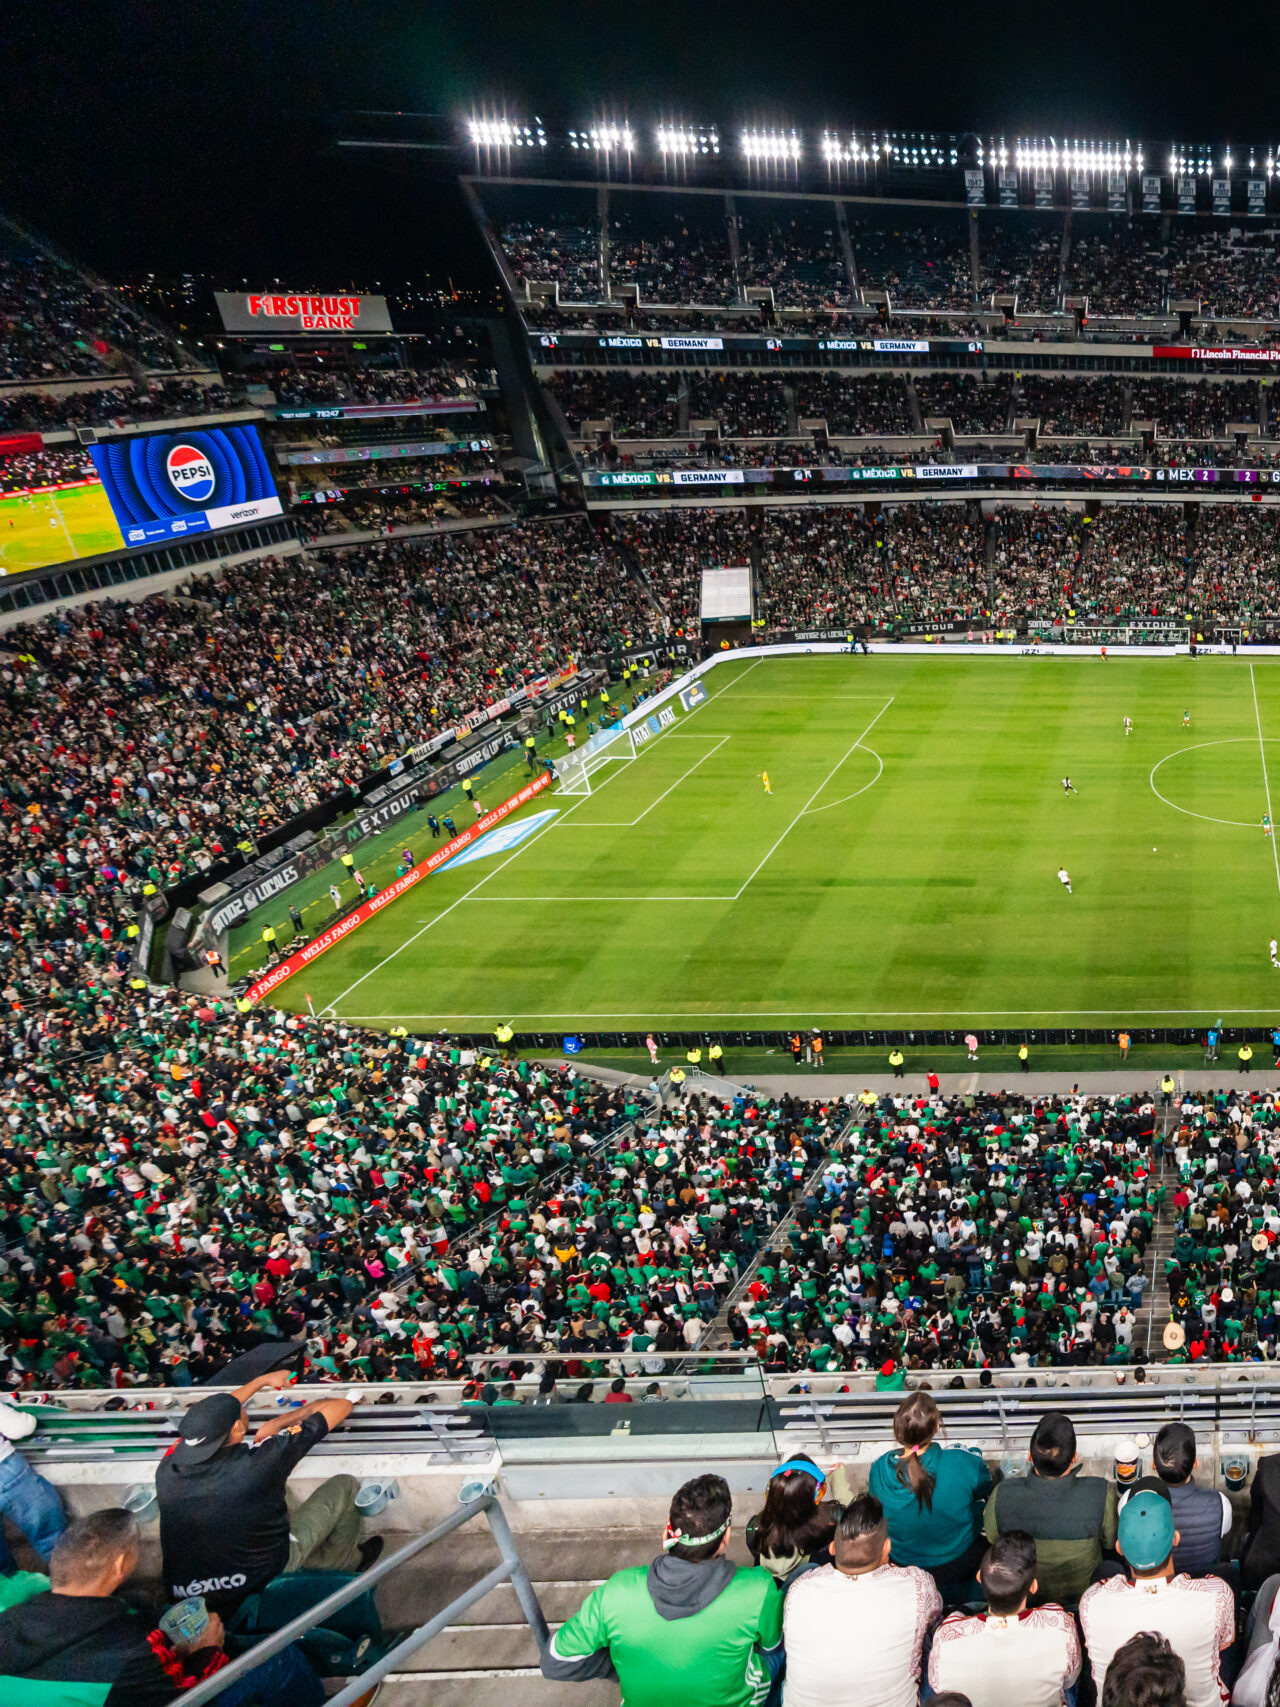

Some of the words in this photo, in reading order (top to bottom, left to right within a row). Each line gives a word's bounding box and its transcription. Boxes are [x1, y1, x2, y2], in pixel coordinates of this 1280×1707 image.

[303, 316, 354, 329] BANK
[646, 339, 661, 348] VS.
[668, 340, 708, 348] GERMANY
[860, 342, 874, 350] VS.
[880, 342, 916, 350] GERMANY
[1201, 350, 1232, 359] Lincoln
[1232, 350, 1270, 360] Financial
[316, 410, 340, 418] 78247
[172, 466, 211, 481] PEPSI
[656, 474, 673, 483] VS.
[680, 473, 727, 482] GERMANY
[900, 469, 916, 477] VS.
[922, 468, 963, 477] GERMANY
[1170, 470, 1194, 480] MEX
[1202, 471, 1208, 480] 2
[1245, 472, 1250, 481] 2
[231, 507, 259, 520] verizon
[900, 623, 954, 633] MEXTOUR
[477, 812, 498, 831] WELLS
[426, 848, 450, 868] WELLS
[450, 832, 472, 852] FARGO
[256, 866, 298, 901] LOCALES
[368, 888, 396, 911] WELLS
[395, 870, 420, 892] FARGO
[301, 935, 332, 961] WELLS
[331, 915, 360, 939] FARGO
[258, 966, 290, 994] FARGO
